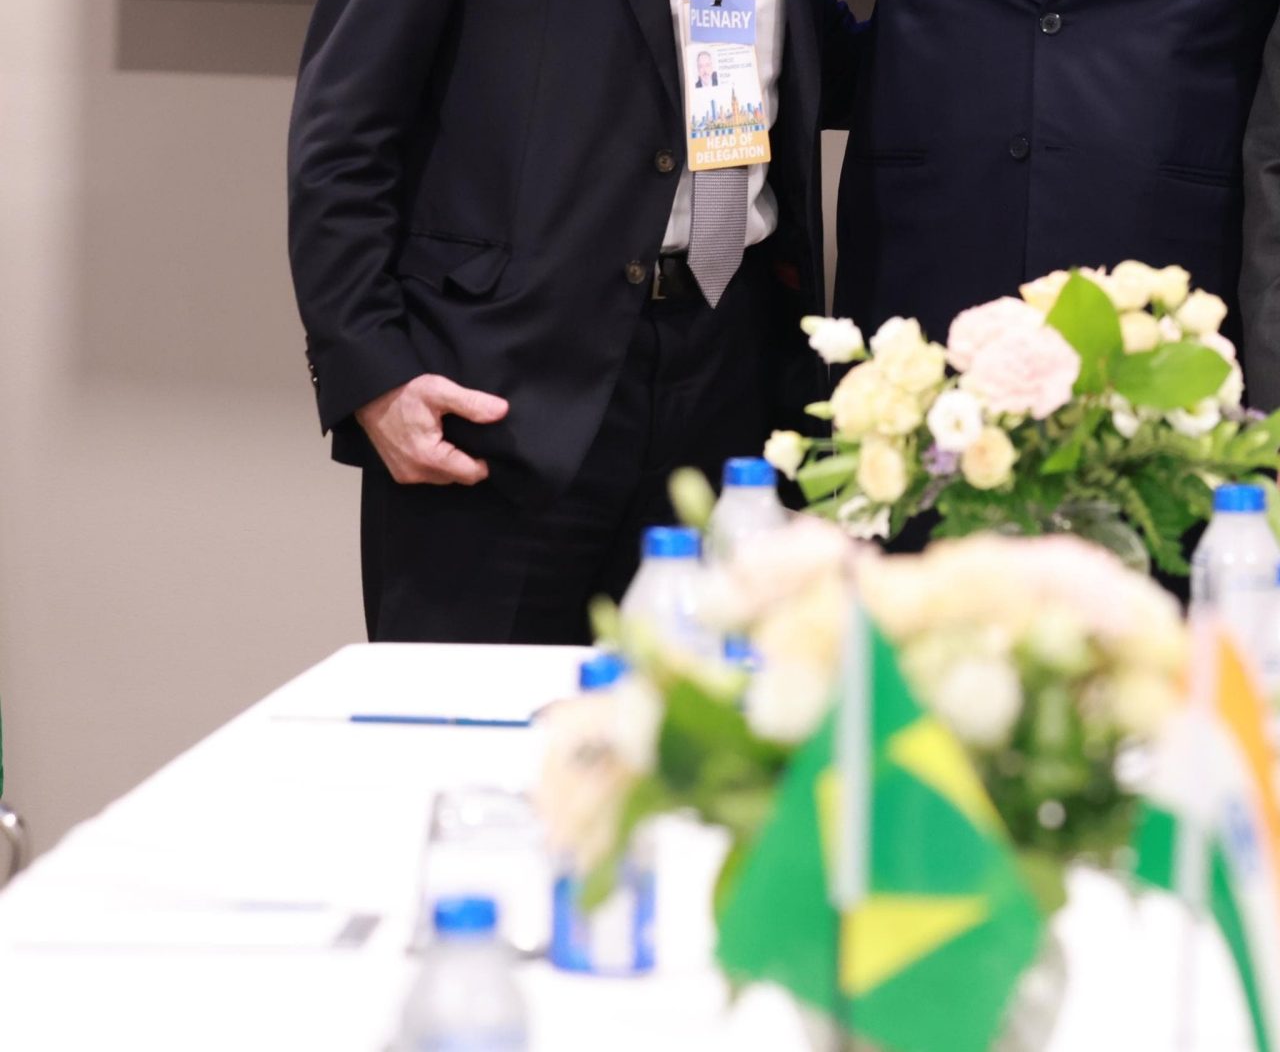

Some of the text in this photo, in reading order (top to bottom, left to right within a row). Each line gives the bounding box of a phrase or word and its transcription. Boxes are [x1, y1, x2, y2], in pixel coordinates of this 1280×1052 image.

[690, 9, 752, 28] PLENARY
[706, 132, 753, 149] HEAD OF
[696, 145, 765, 165] DELEGATION
